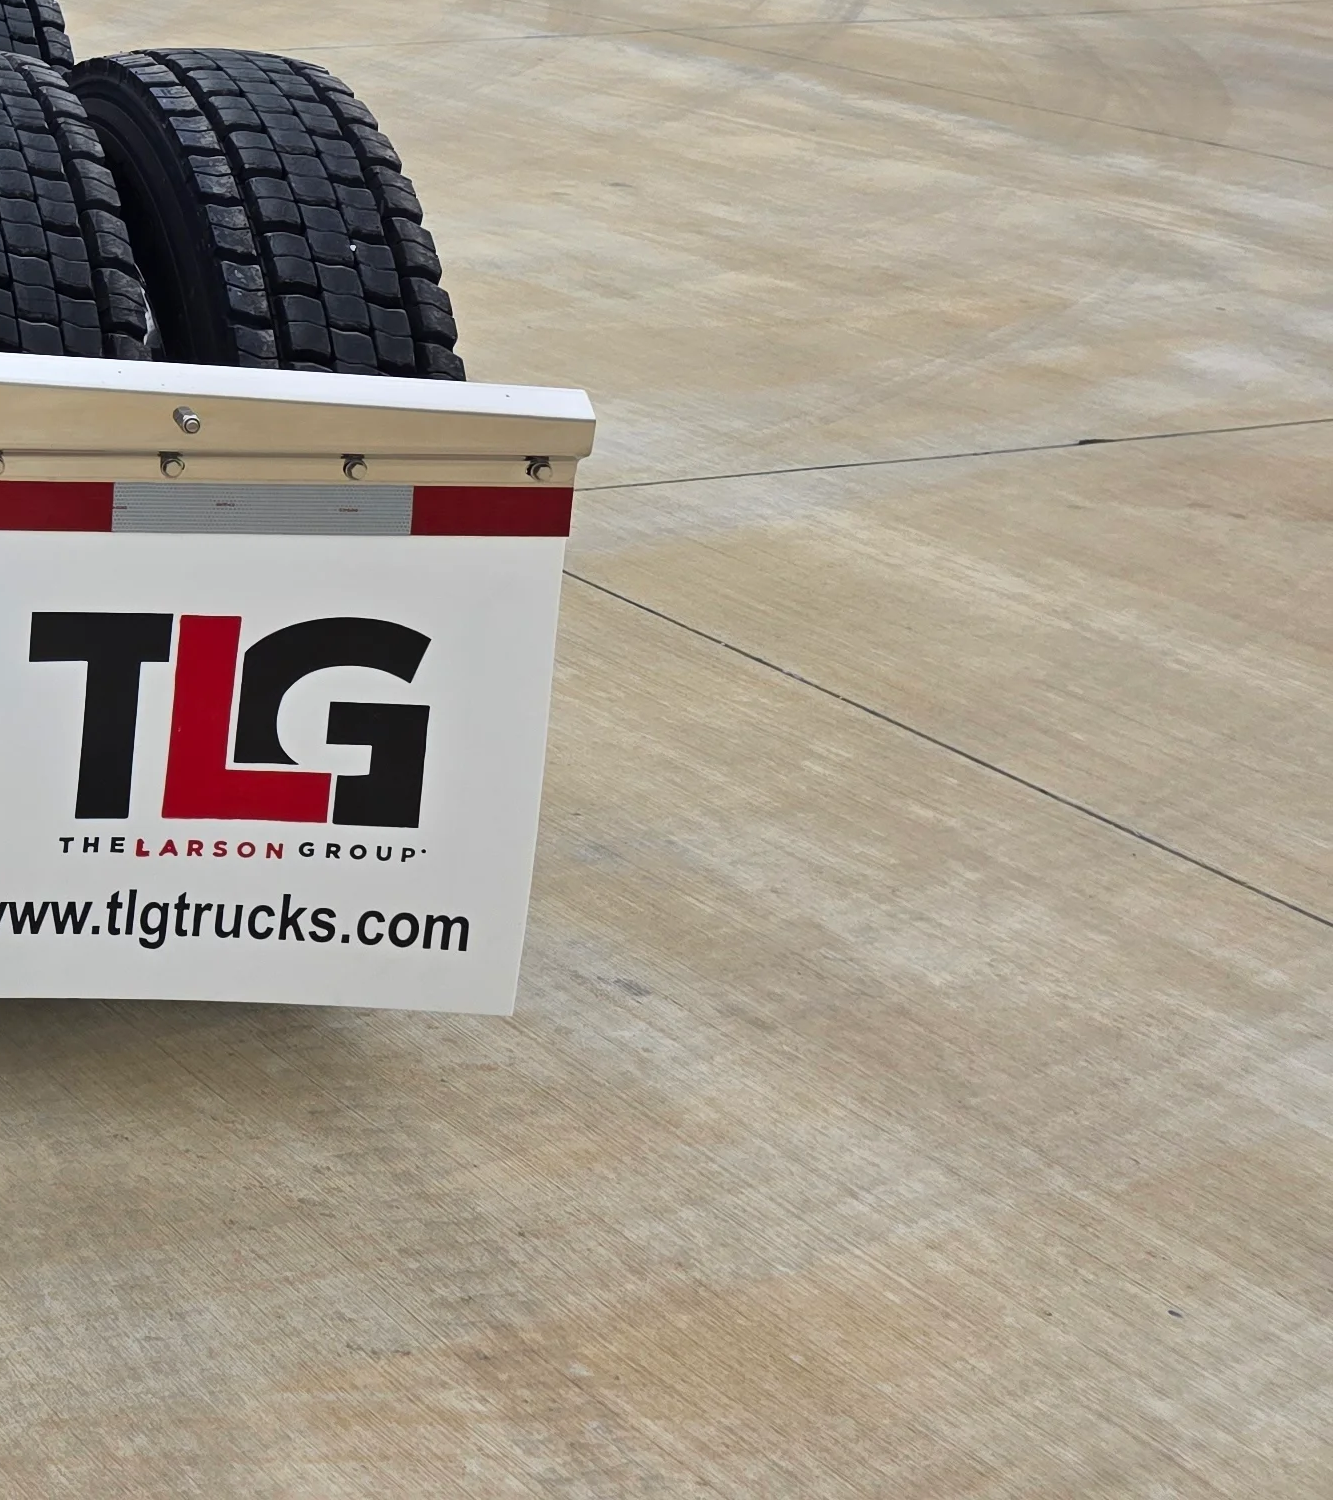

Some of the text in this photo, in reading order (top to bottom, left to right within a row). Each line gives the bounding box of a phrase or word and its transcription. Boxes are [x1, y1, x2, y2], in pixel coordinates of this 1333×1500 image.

[28, 611, 432, 829] TLG
[58, 836, 416, 863] THE LARSON GROUP
